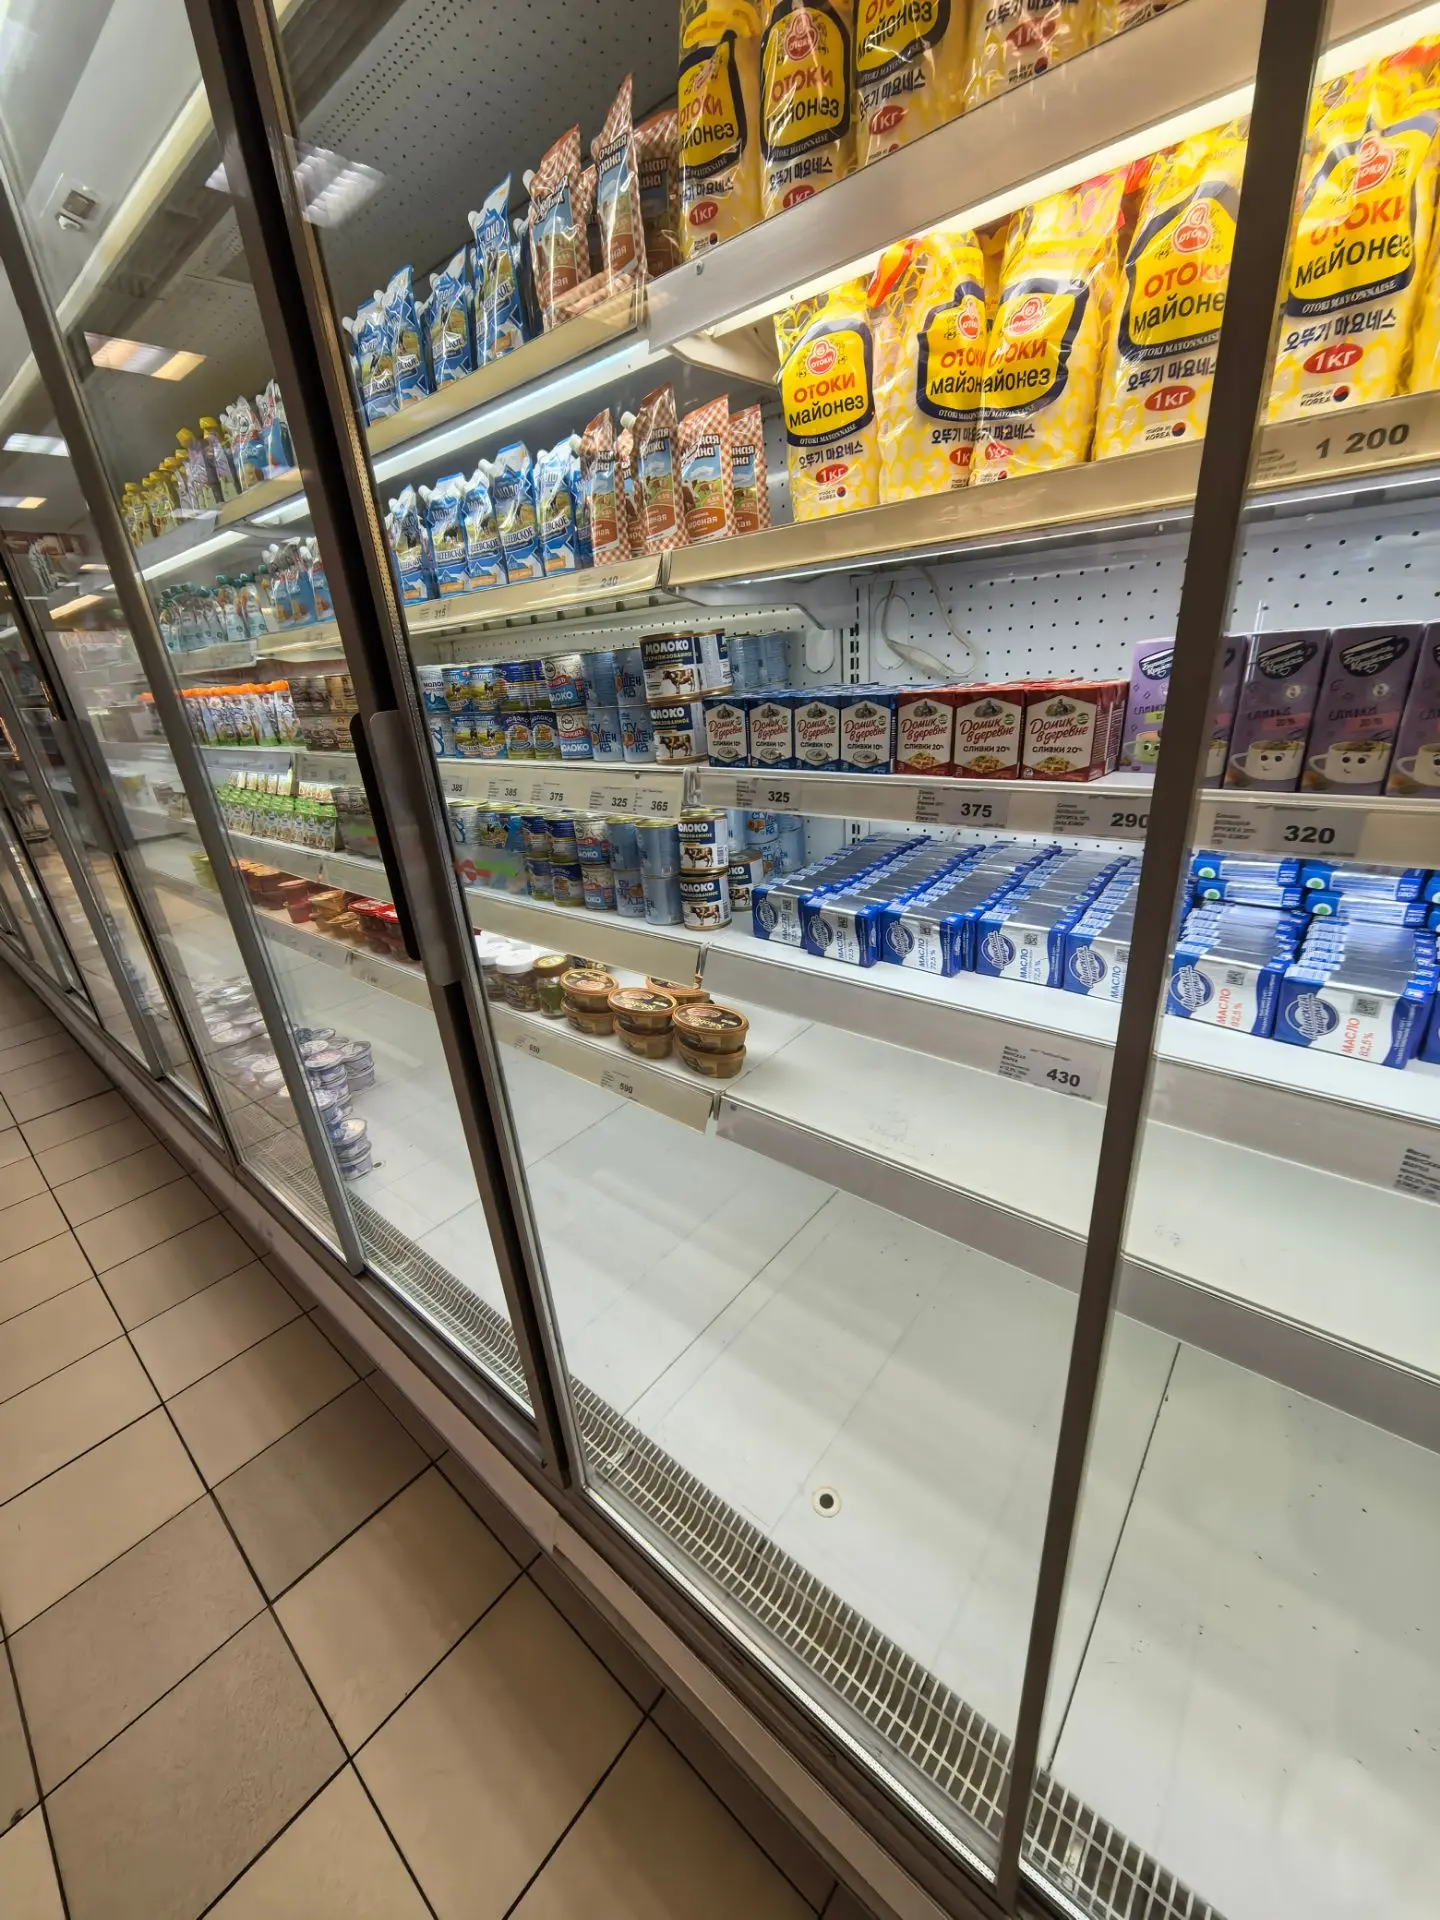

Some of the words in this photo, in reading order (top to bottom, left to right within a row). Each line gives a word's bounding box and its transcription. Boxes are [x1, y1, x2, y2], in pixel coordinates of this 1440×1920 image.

[771, 68, 834, 103] ОТОКИ
[767, 96, 840, 139] йонез
[681, 122, 736, 149] йонез
[1132, 290, 1226, 338] майоне
[1283, 320, 1332, 354] 오뚜기
[1334, 307, 1397, 337] 마요네스
[1314, 350, 1357, 372] 1кг
[793, 371, 857, 405] ОТОКИ
[929, 370, 983, 396] майон
[982, 367, 1051, 395] айонез
[1126, 363, 1165, 393] 오뚜기
[1151, 389, 1191, 411] 1кг
[788, 394, 865, 430] майонез
[930, 427, 962, 446] 오뚜기
[1315, 437, 1332, 461] 1
[1343, 423, 1411, 455] 200
[798, 453, 825, 471] 오뚜기
[826, 439, 865, 462] 마요네스
[645, 639, 690, 655] МОЛОКО
[651, 706, 685, 719] ОЛОКО
[844, 719, 877, 734] Домик
[900, 717, 938, 735] Домик
[912, 724, 948, 743] деревне
[960, 717, 1002, 736] Домик
[973, 724, 1016, 745] деревне
[1029, 716, 1076, 735] Домик
[1043, 724, 1089, 746] деревне
[561, 743, 590, 753] ОЛОКО
[504, 788, 518, 797] 385
[549, 791, 564, 802] 375
[611, 797, 628, 808] 325
[767, 790, 791, 804] 325
[650, 800, 669, 812] 365
[960, 802, 993, 818] 375
[678, 823, 709, 832] ОЛОКО
[1109, 812, 1150, 829] 290
[1283, 825, 1336, 844] 320
[681, 882, 715, 892] ОЛОКО
[1019, 948, 1028, 979] МАСЛО
[1109, 965, 1122, 999] МАСЛО
[1216, 987, 1231, 1025] МАСЛО
[1341, 1017, 1361, 1055] МАСЛО
